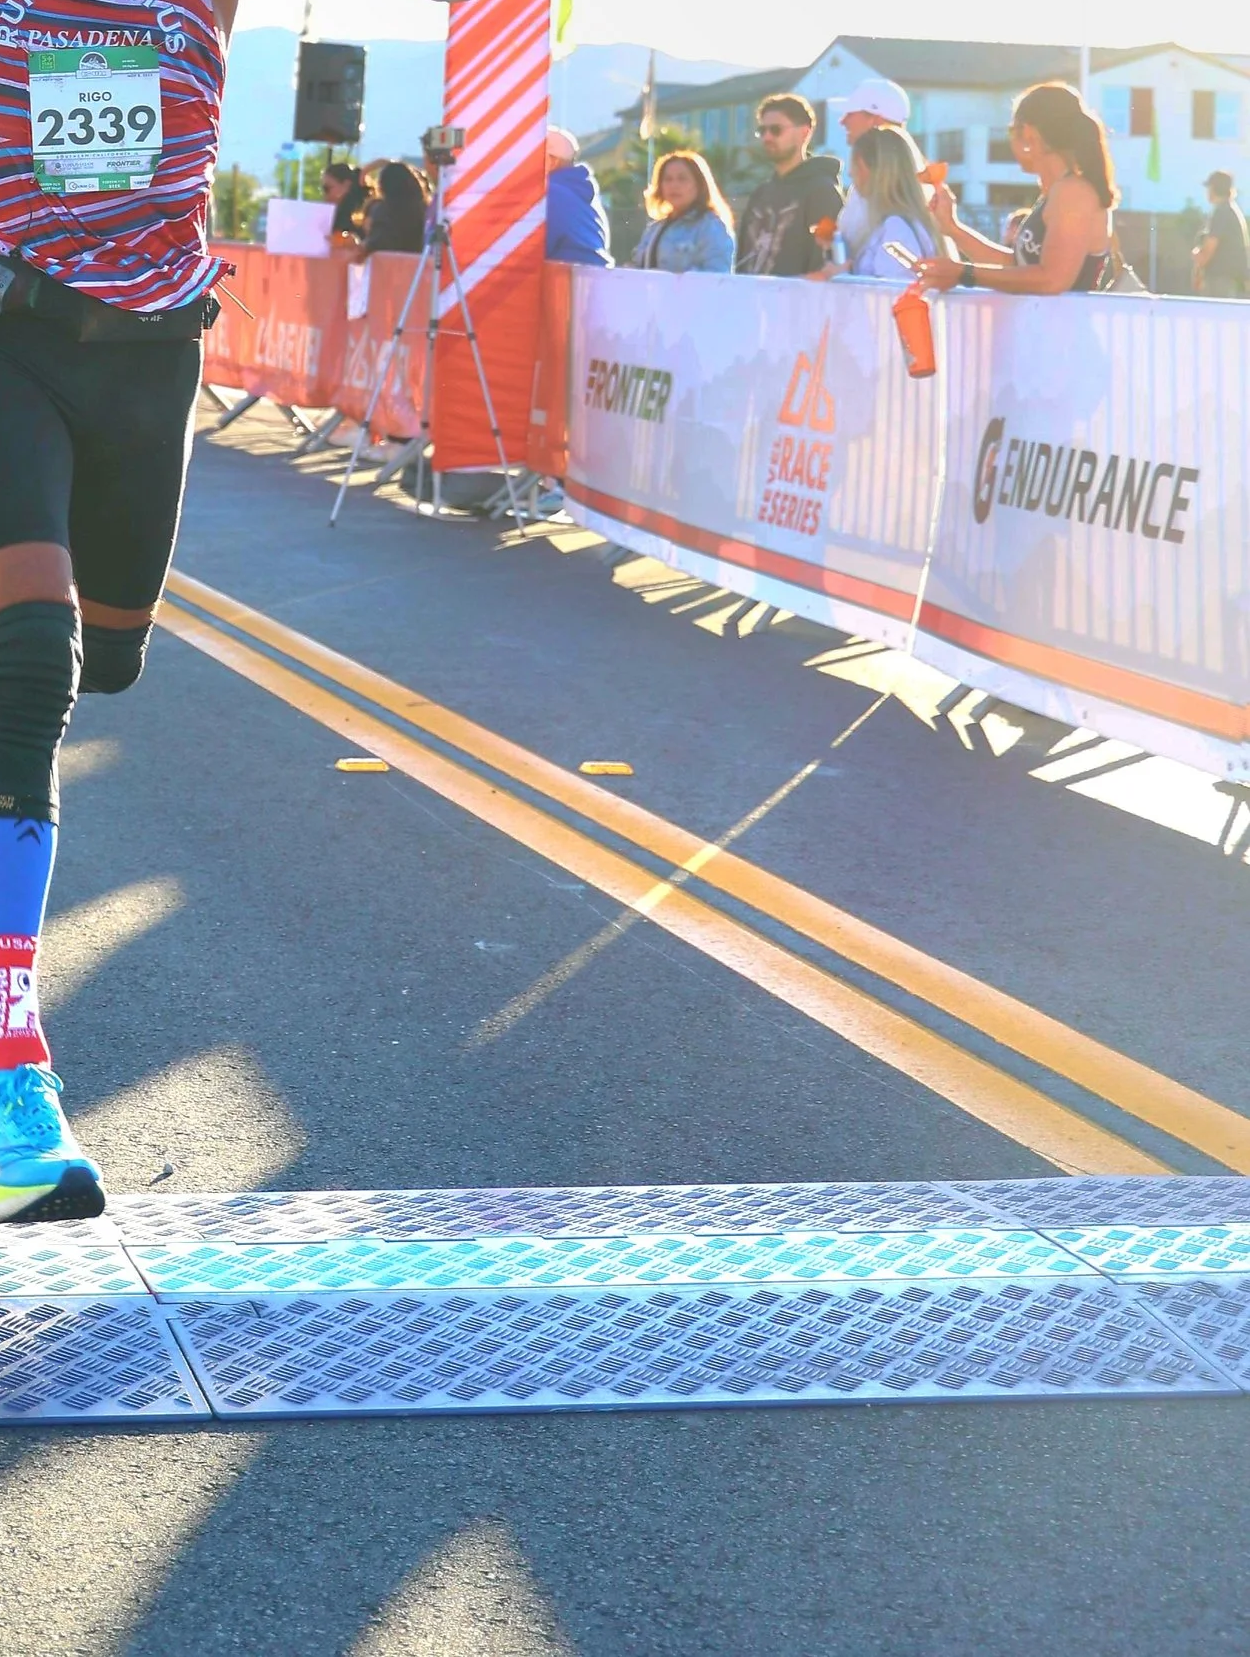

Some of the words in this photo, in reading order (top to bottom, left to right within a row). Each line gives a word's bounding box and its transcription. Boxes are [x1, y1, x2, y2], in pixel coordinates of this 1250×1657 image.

[28, 30, 154, 49] PASADENA
[156, 4, 187, 54] US
[79, 91, 112, 103] RIGO
[37, 105, 157, 147] 2339
[106, 159, 141, 168] FRONTIER
[584, 359, 673, 423] FRONTIER
[777, 435, 833, 491] RACE
[997, 438, 1200, 544] ENDURANCE
[768, 492, 823, 536] SERIES
